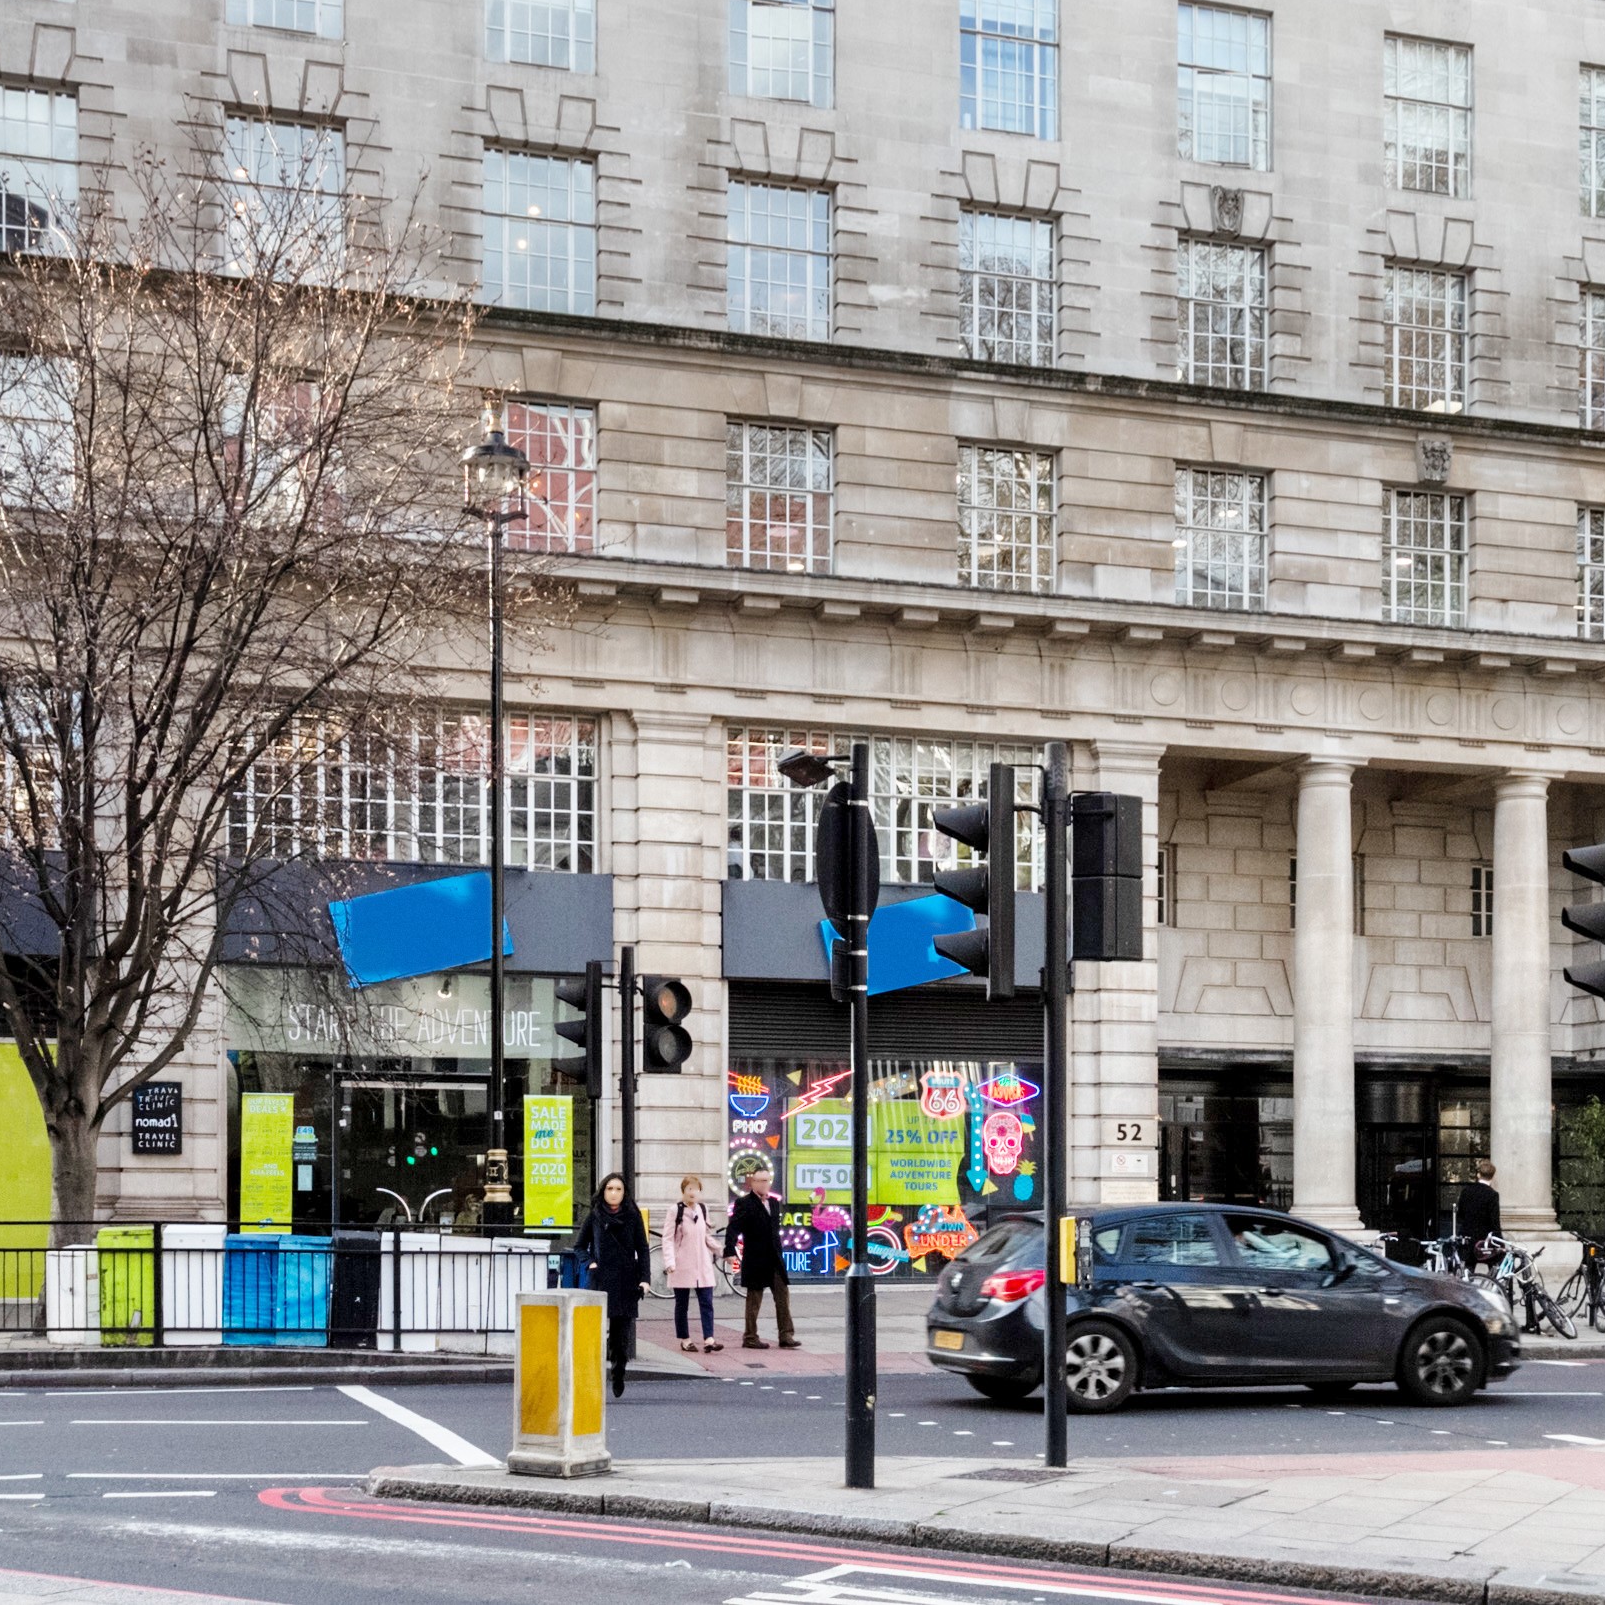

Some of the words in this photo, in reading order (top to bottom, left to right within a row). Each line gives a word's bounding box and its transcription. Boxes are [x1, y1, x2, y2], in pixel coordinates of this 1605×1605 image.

[288, 1004, 353, 1042] START
[417, 1007, 541, 1047] ADVENURE
[929, 1089, 960, 1113] 66
[532, 1106, 566, 1119] SALE
[531, 1120, 566, 1131] MADE
[907, 1116, 919, 1124] UP
[535, 1129, 554, 1138] me
[802, 1119, 854, 1140] 202
[1117, 1124, 1142, 1141] 52
[885, 1130, 922, 1144] 25%
[927, 1131, 958, 1144] OFF
[532, 1138, 550, 1149] DO
[554, 1138, 566, 1149] IT
[890, 1159, 951, 1168] WORLDWIDE
[532, 1164, 567, 1175] 2020
[890, 1170, 951, 1179] ADVENTURE
[531, 1177, 547, 1185] IT'S
[802, 1169, 831, 1183] IT'S
[905, 1182, 938, 1191] TOURS
[920, 1234, 967, 1247] UNDER
